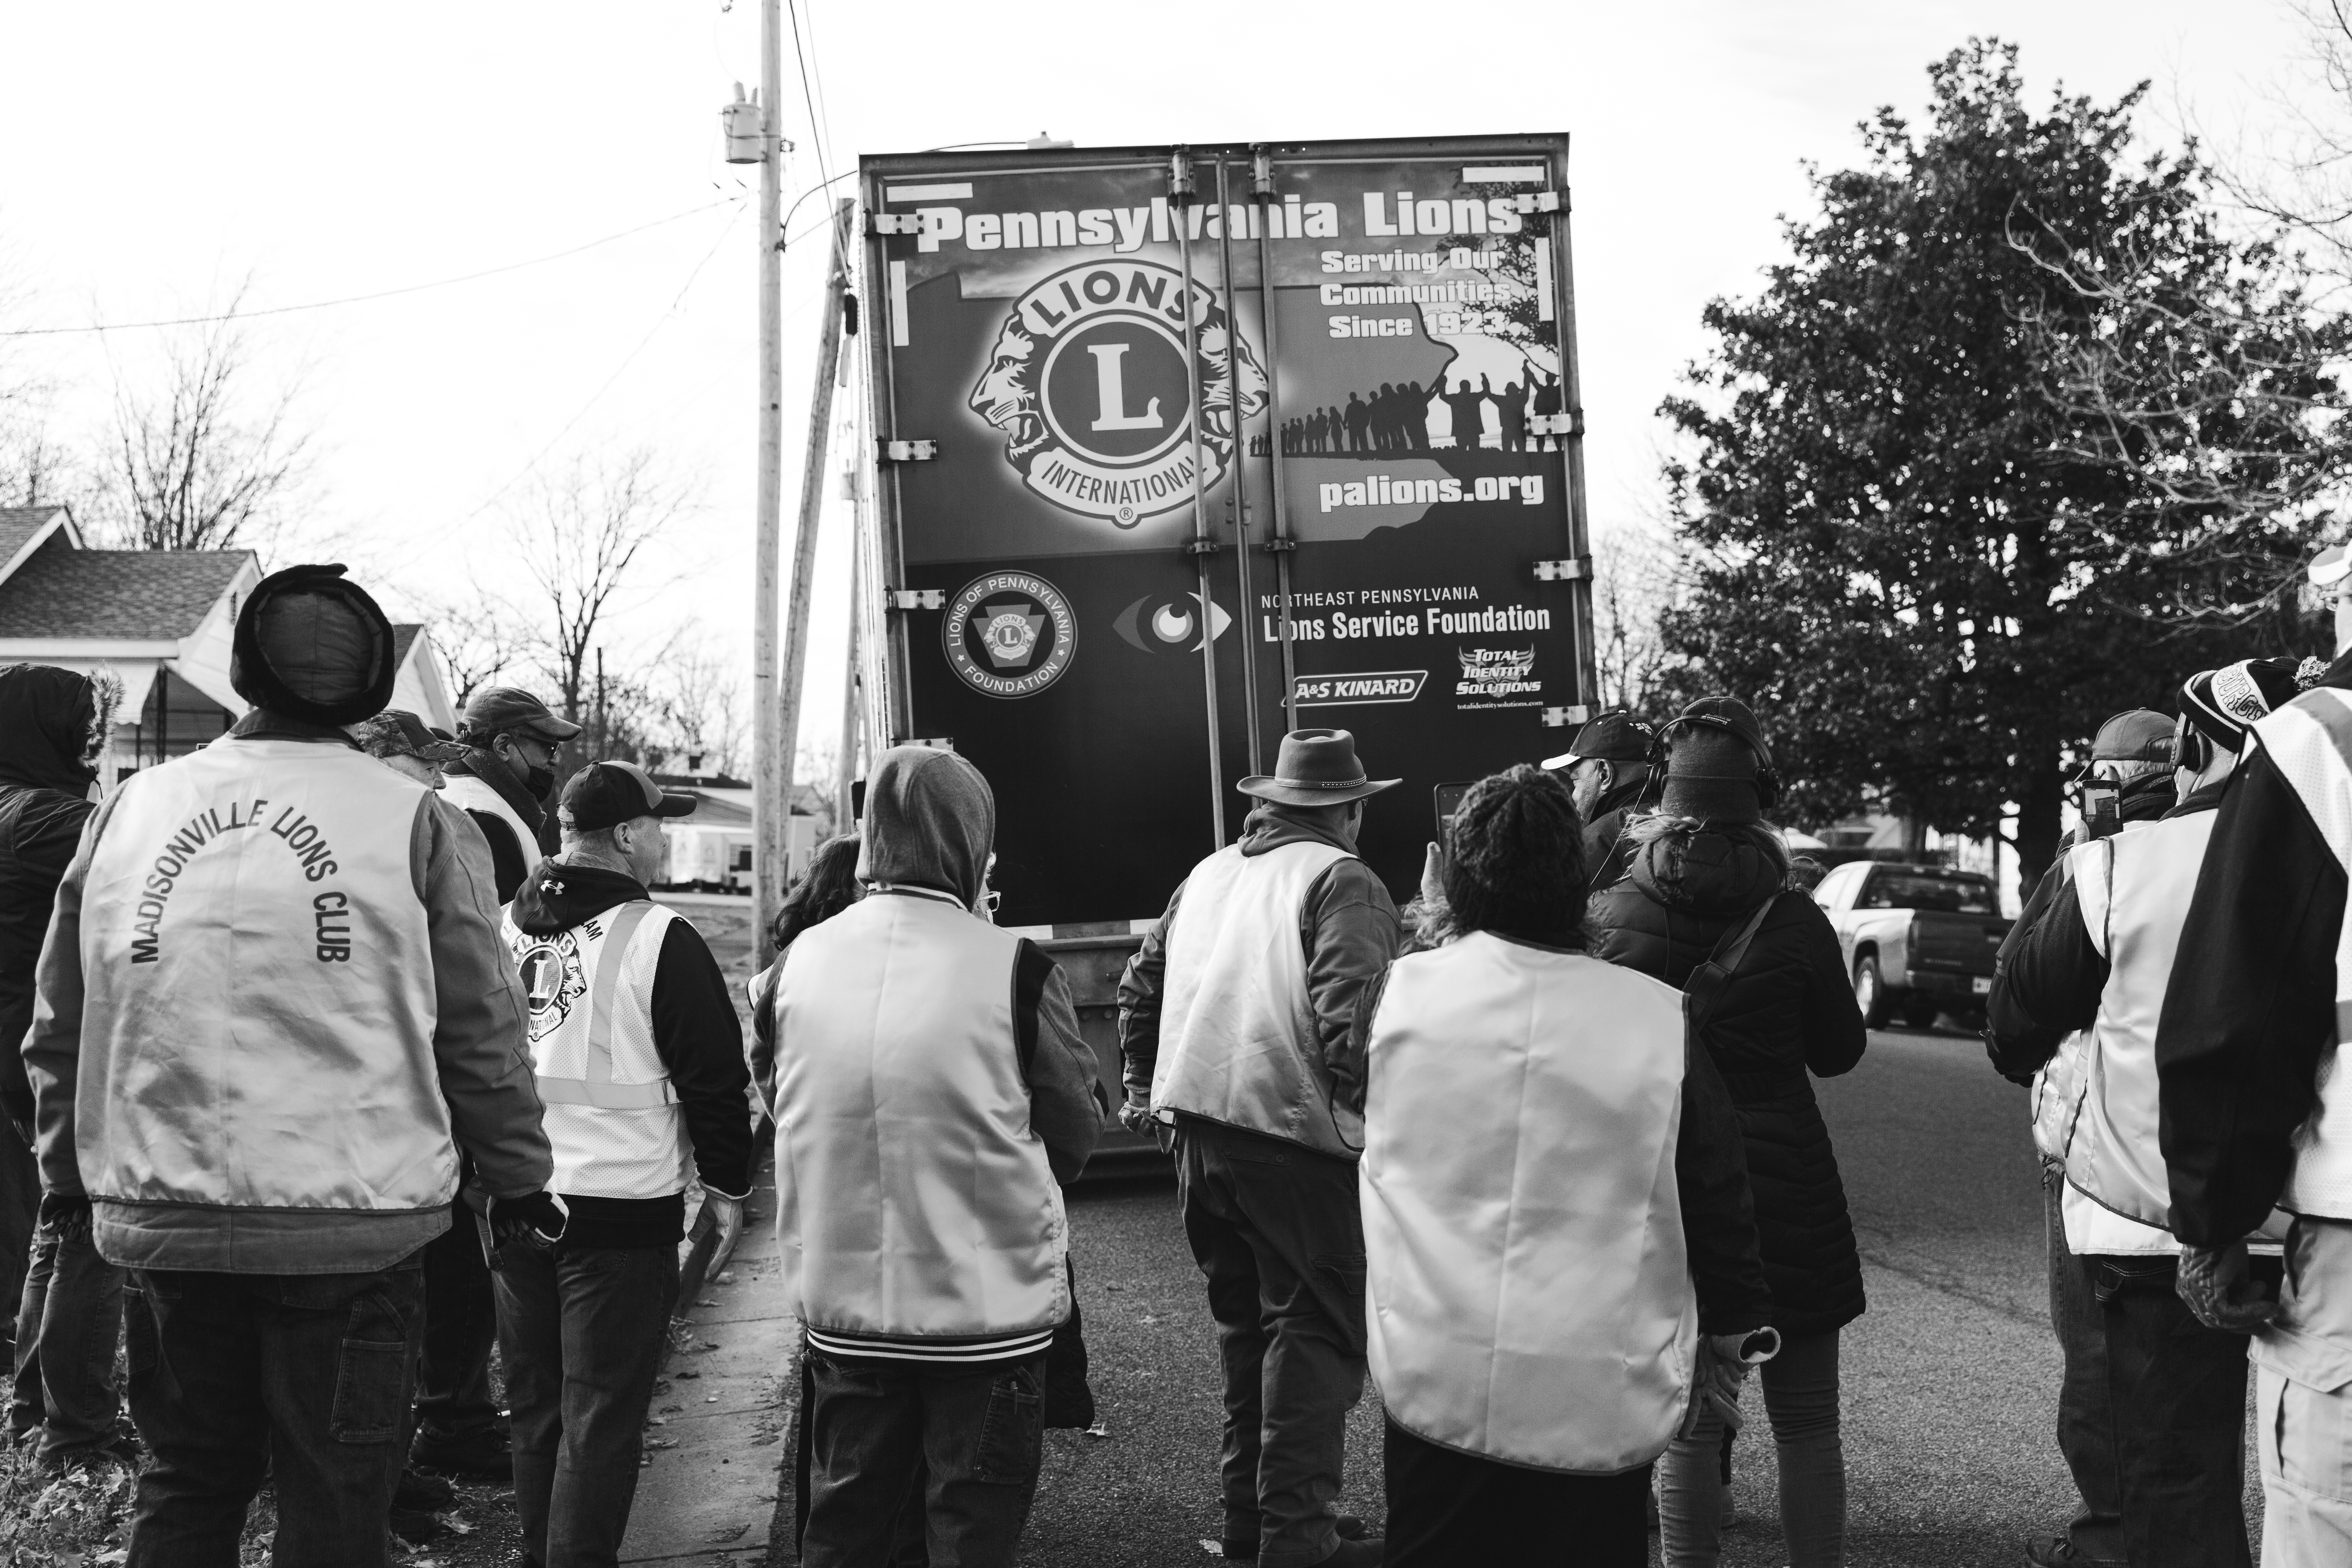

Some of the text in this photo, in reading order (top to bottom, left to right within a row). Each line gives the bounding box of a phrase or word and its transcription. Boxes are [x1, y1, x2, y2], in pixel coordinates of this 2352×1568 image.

[916, 191, 1522, 253] Pennsylvania Lions
[1321, 247, 1506, 274] Serving Our
[1030, 270, 1200, 328] LIONS
[1320, 280, 1511, 305] Communities
[1328, 311, 1506, 338] Since 1923
[1087, 343, 1163, 431] L
[1319, 475, 1544, 513] palions.org
[1361, 586, 1479, 604] PENNSYLVANIA
[949, 577, 1069, 647] LIONS OF PENNSYLVANIA
[995, 615, 1024, 625] LIONS
[1332, 610, 1419, 639] Service
[1427, 604, 1551, 635] Foundation
[1003, 627, 1018, 644] L
[1473, 648, 1520, 662] TOTAL
[964, 662, 1058, 692] FOUNDATION
[1463, 665, 1532, 679] IDENTITY
[1294, 678, 1415, 699] A&S KINARD
[1456, 681, 1542, 695] SOLUTIONS
[1457, 700, 1544, 710] totalidentitysolutions.com
[131, 799, 351, 964] MADISONVILLE LIONS CLUB
[529, 960, 550, 999] L
